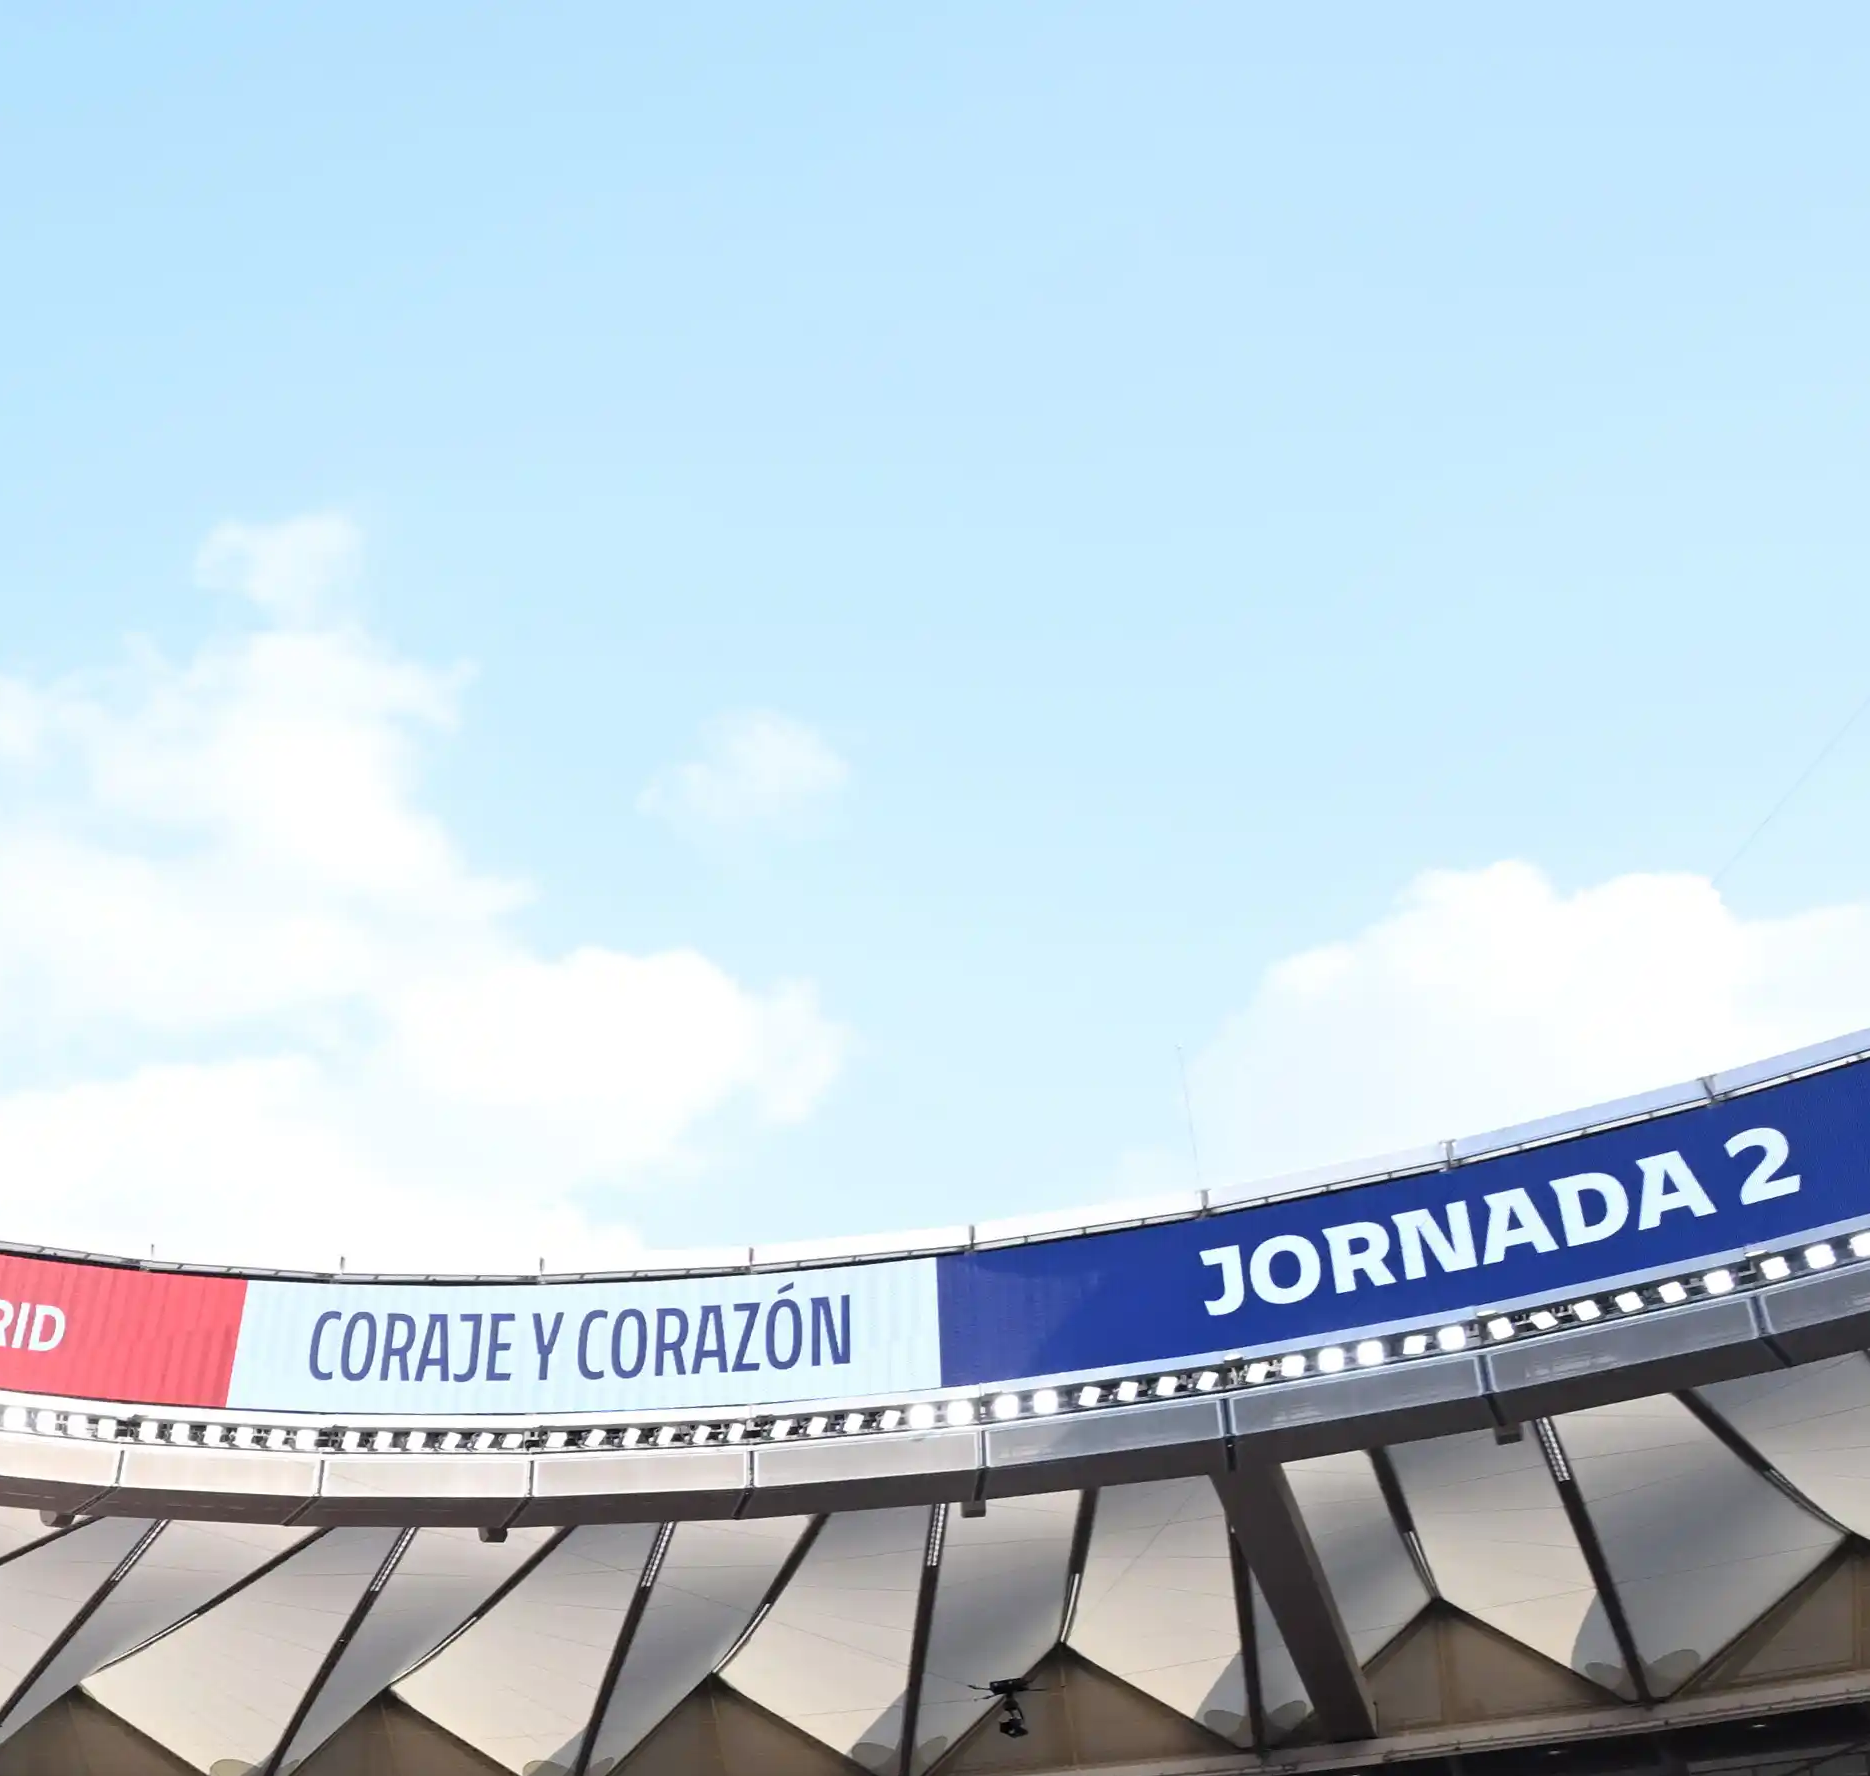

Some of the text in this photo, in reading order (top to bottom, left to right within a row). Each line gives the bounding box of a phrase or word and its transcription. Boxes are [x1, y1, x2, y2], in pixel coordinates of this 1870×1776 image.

[1197, 1126, 1803, 1317] JORNADA 2
[308, 1281, 852, 1384] CORAJE Y CORAZÓN
